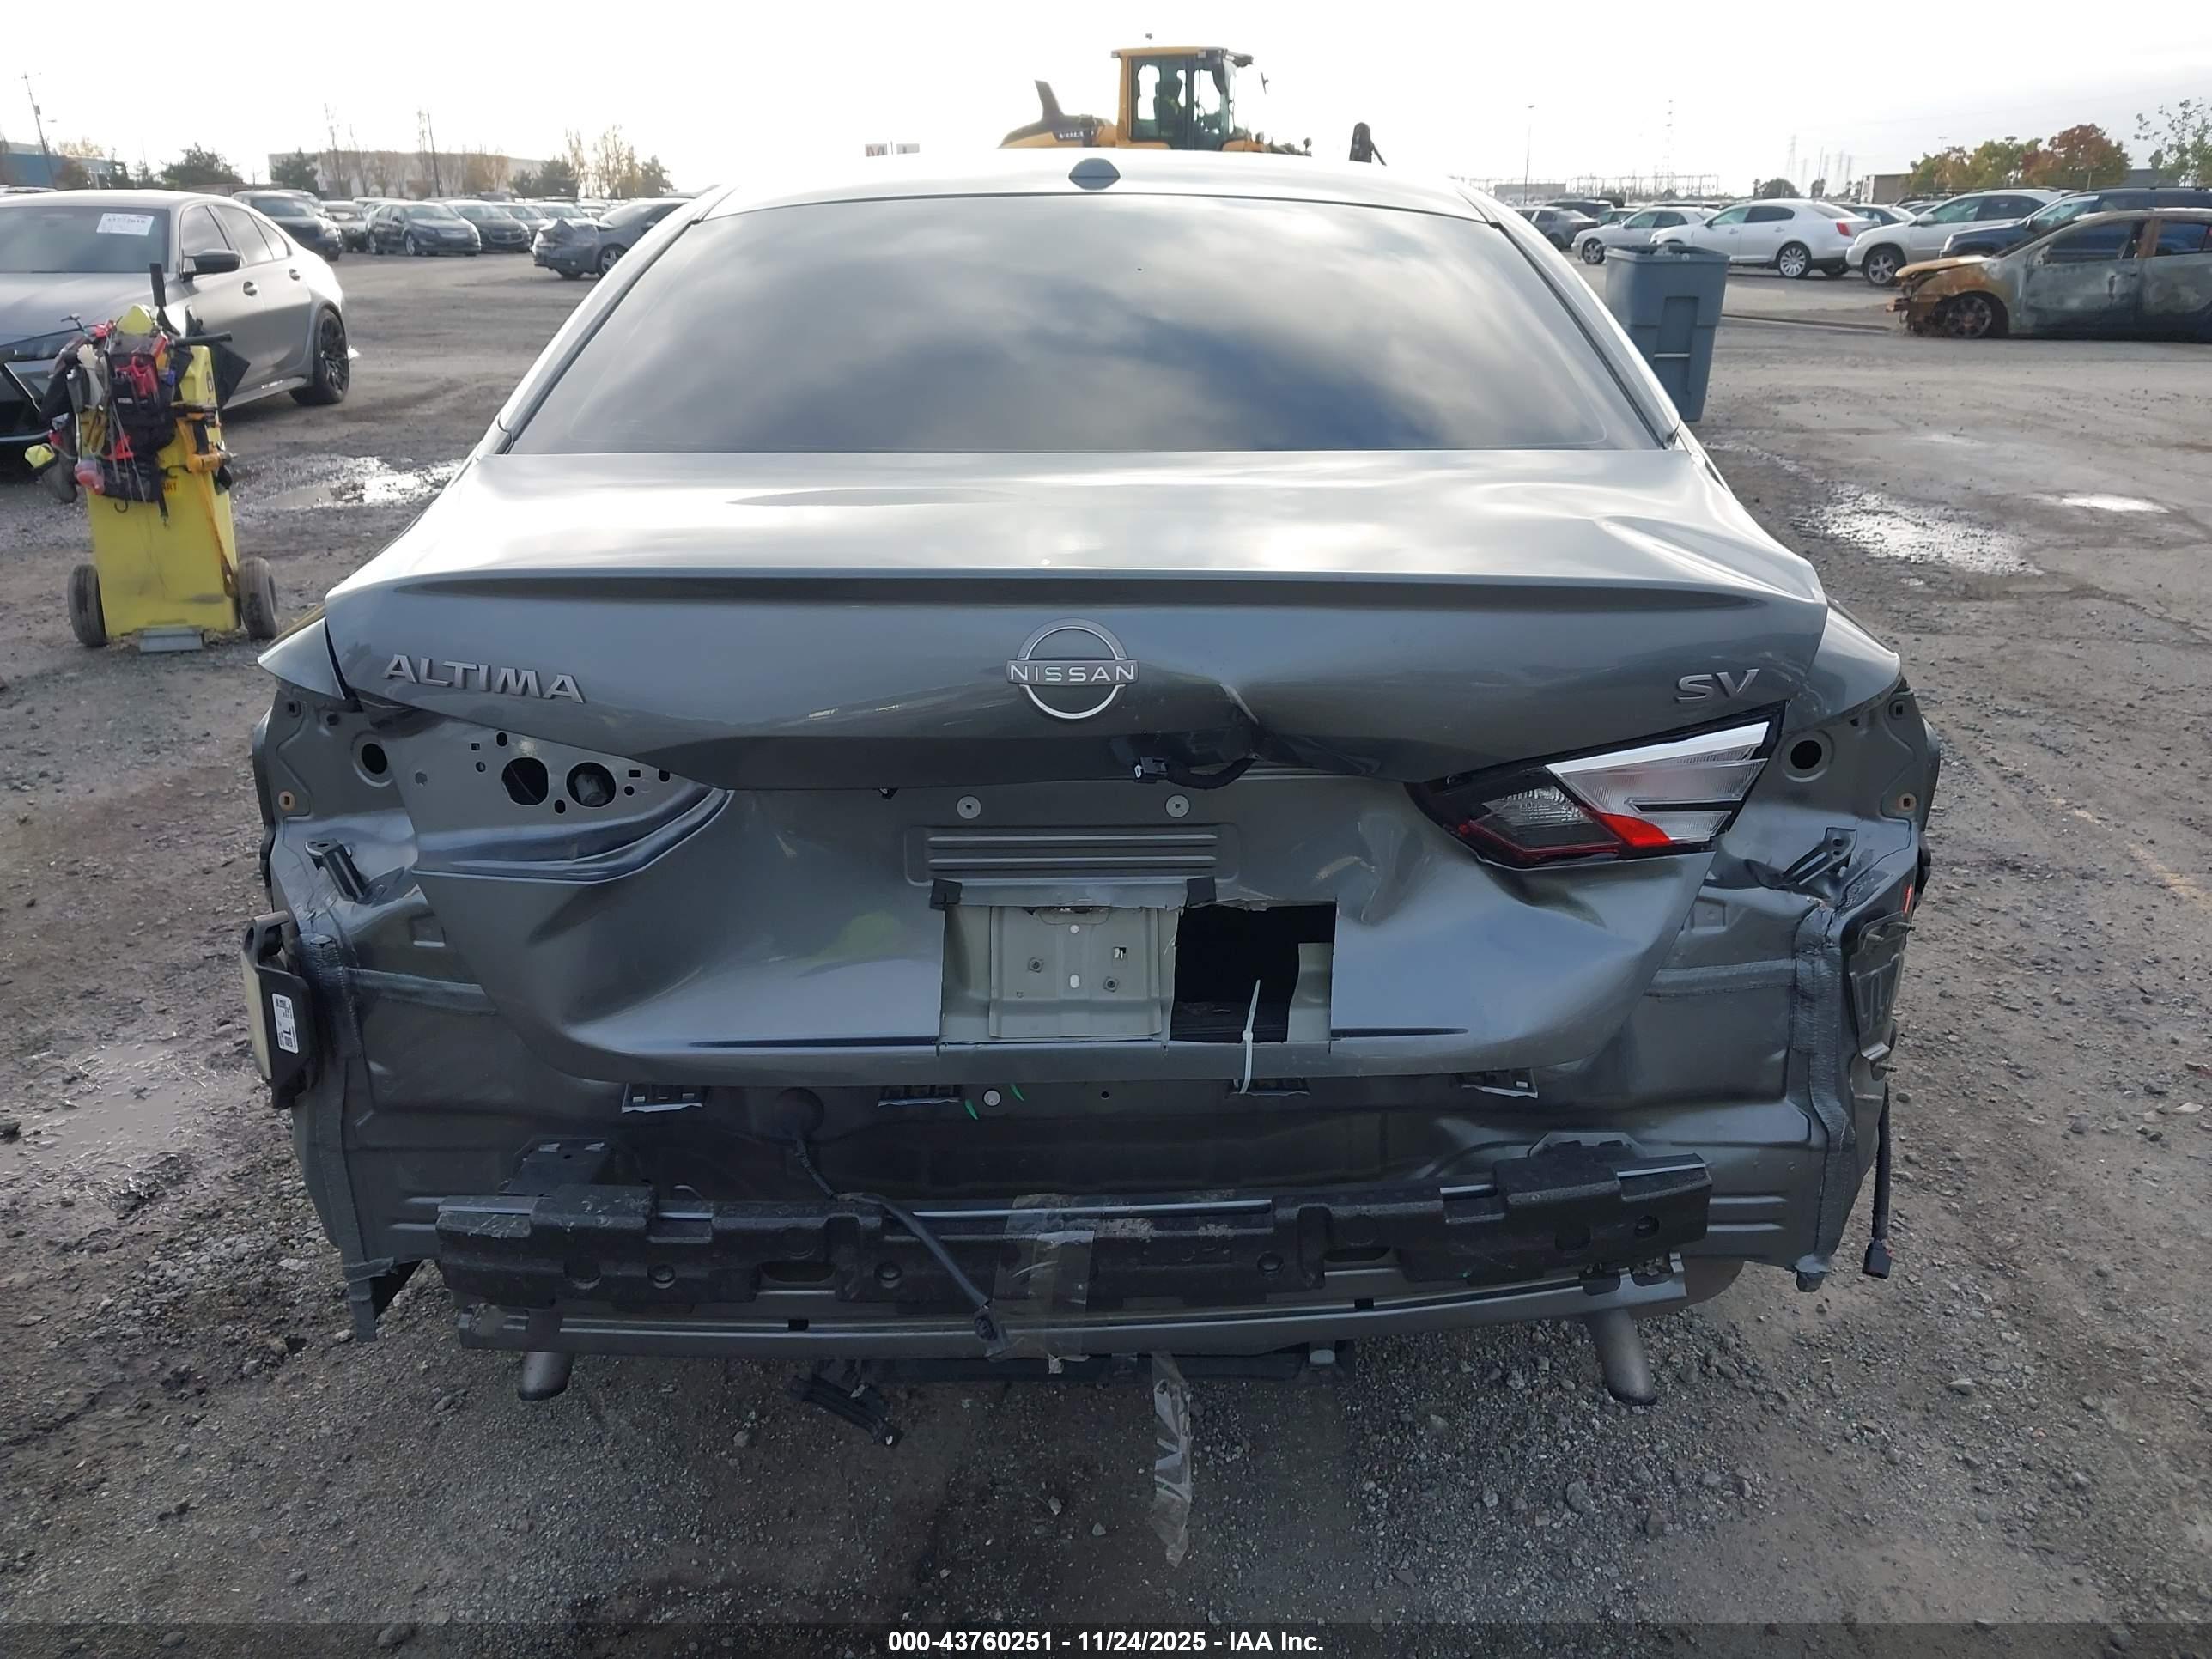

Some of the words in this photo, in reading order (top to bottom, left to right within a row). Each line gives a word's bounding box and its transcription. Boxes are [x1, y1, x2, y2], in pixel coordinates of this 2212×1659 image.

[384, 653, 585, 703] ALTIMA
[1010, 665, 1134, 682] NISSAN
[1675, 668, 1760, 702] SV
